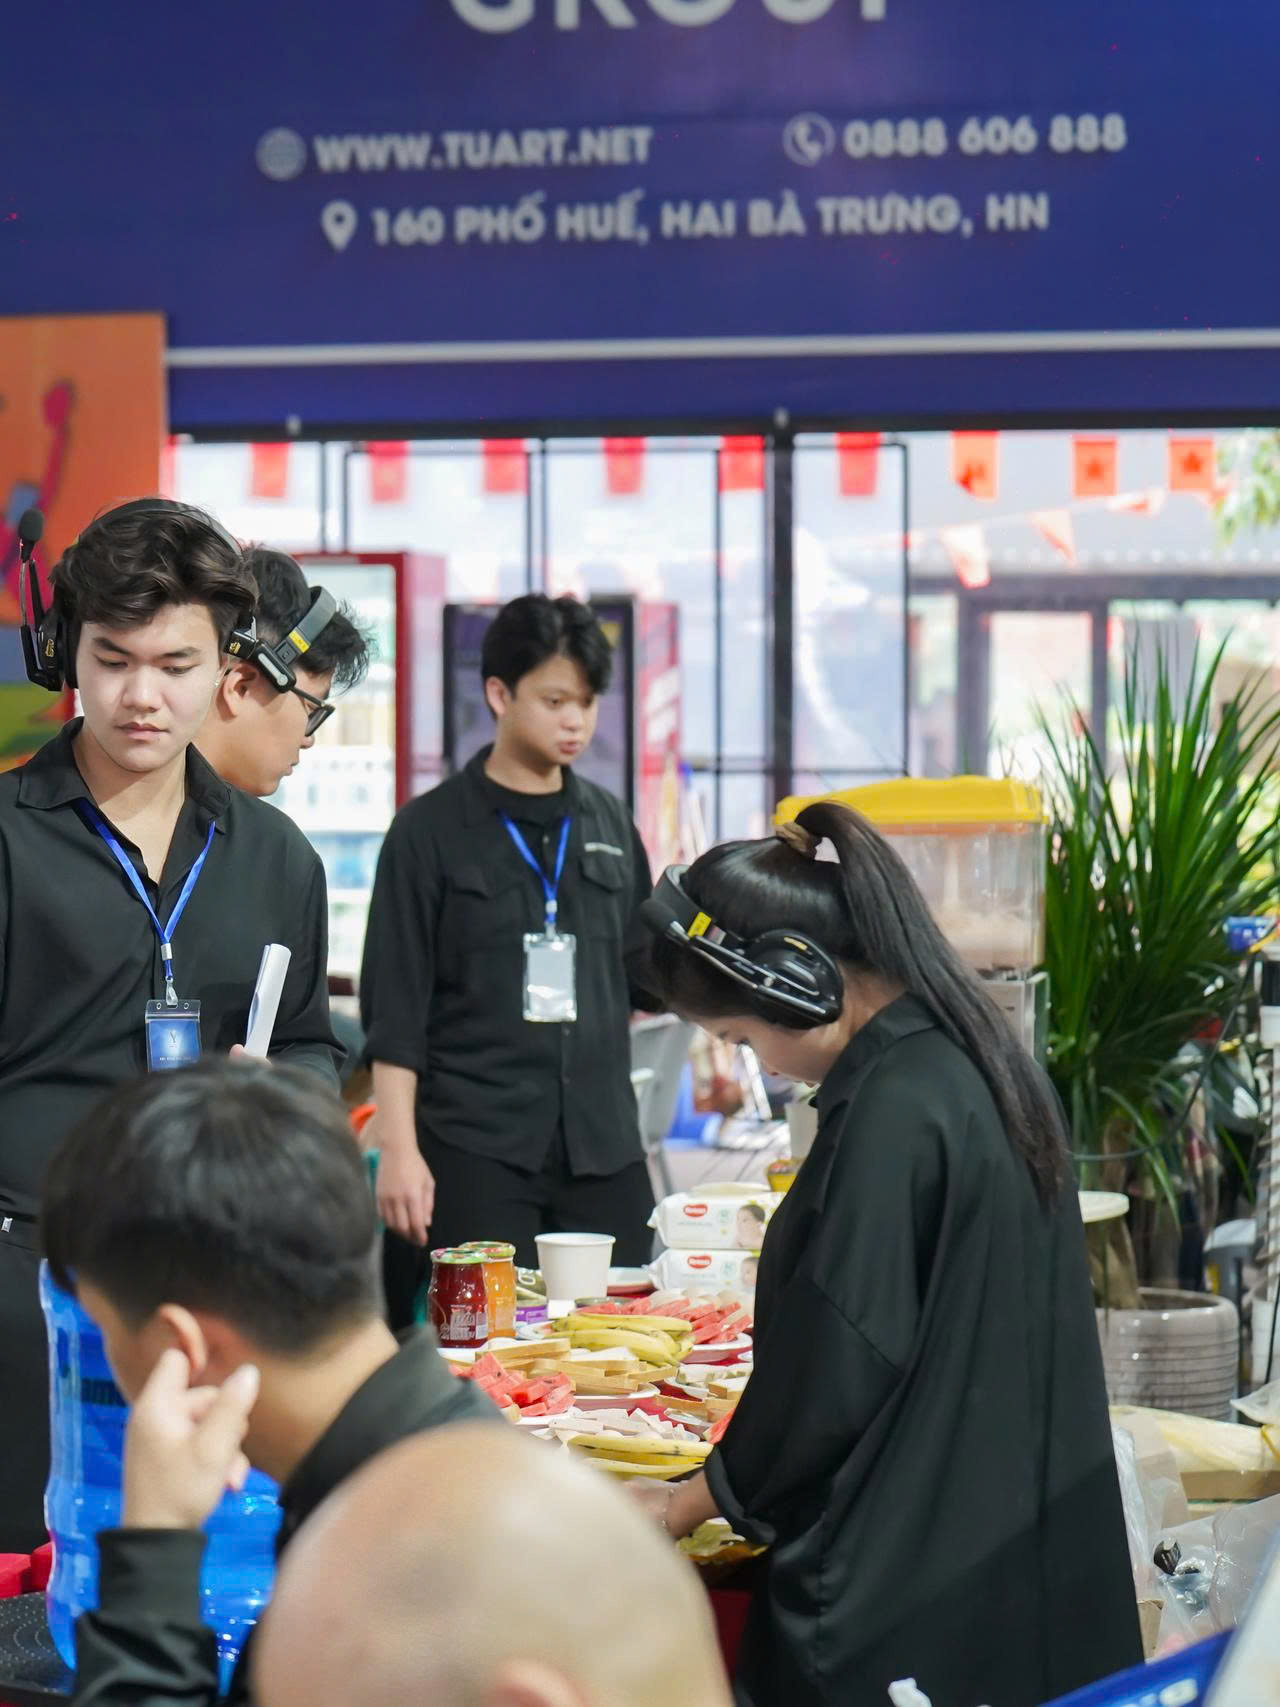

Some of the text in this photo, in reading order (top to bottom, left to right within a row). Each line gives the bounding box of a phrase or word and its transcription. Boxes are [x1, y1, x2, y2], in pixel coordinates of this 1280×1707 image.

[314, 126, 653, 173] WWW.TUART.NET
[843, 112, 1127, 158] 0888 606 888
[371, 205, 445, 246] 160
[454, 190, 546, 244] PHỐ
[660, 199, 736, 239] HAI
[747, 189, 807, 237] BÀ
[985, 191, 1048, 231] HN
